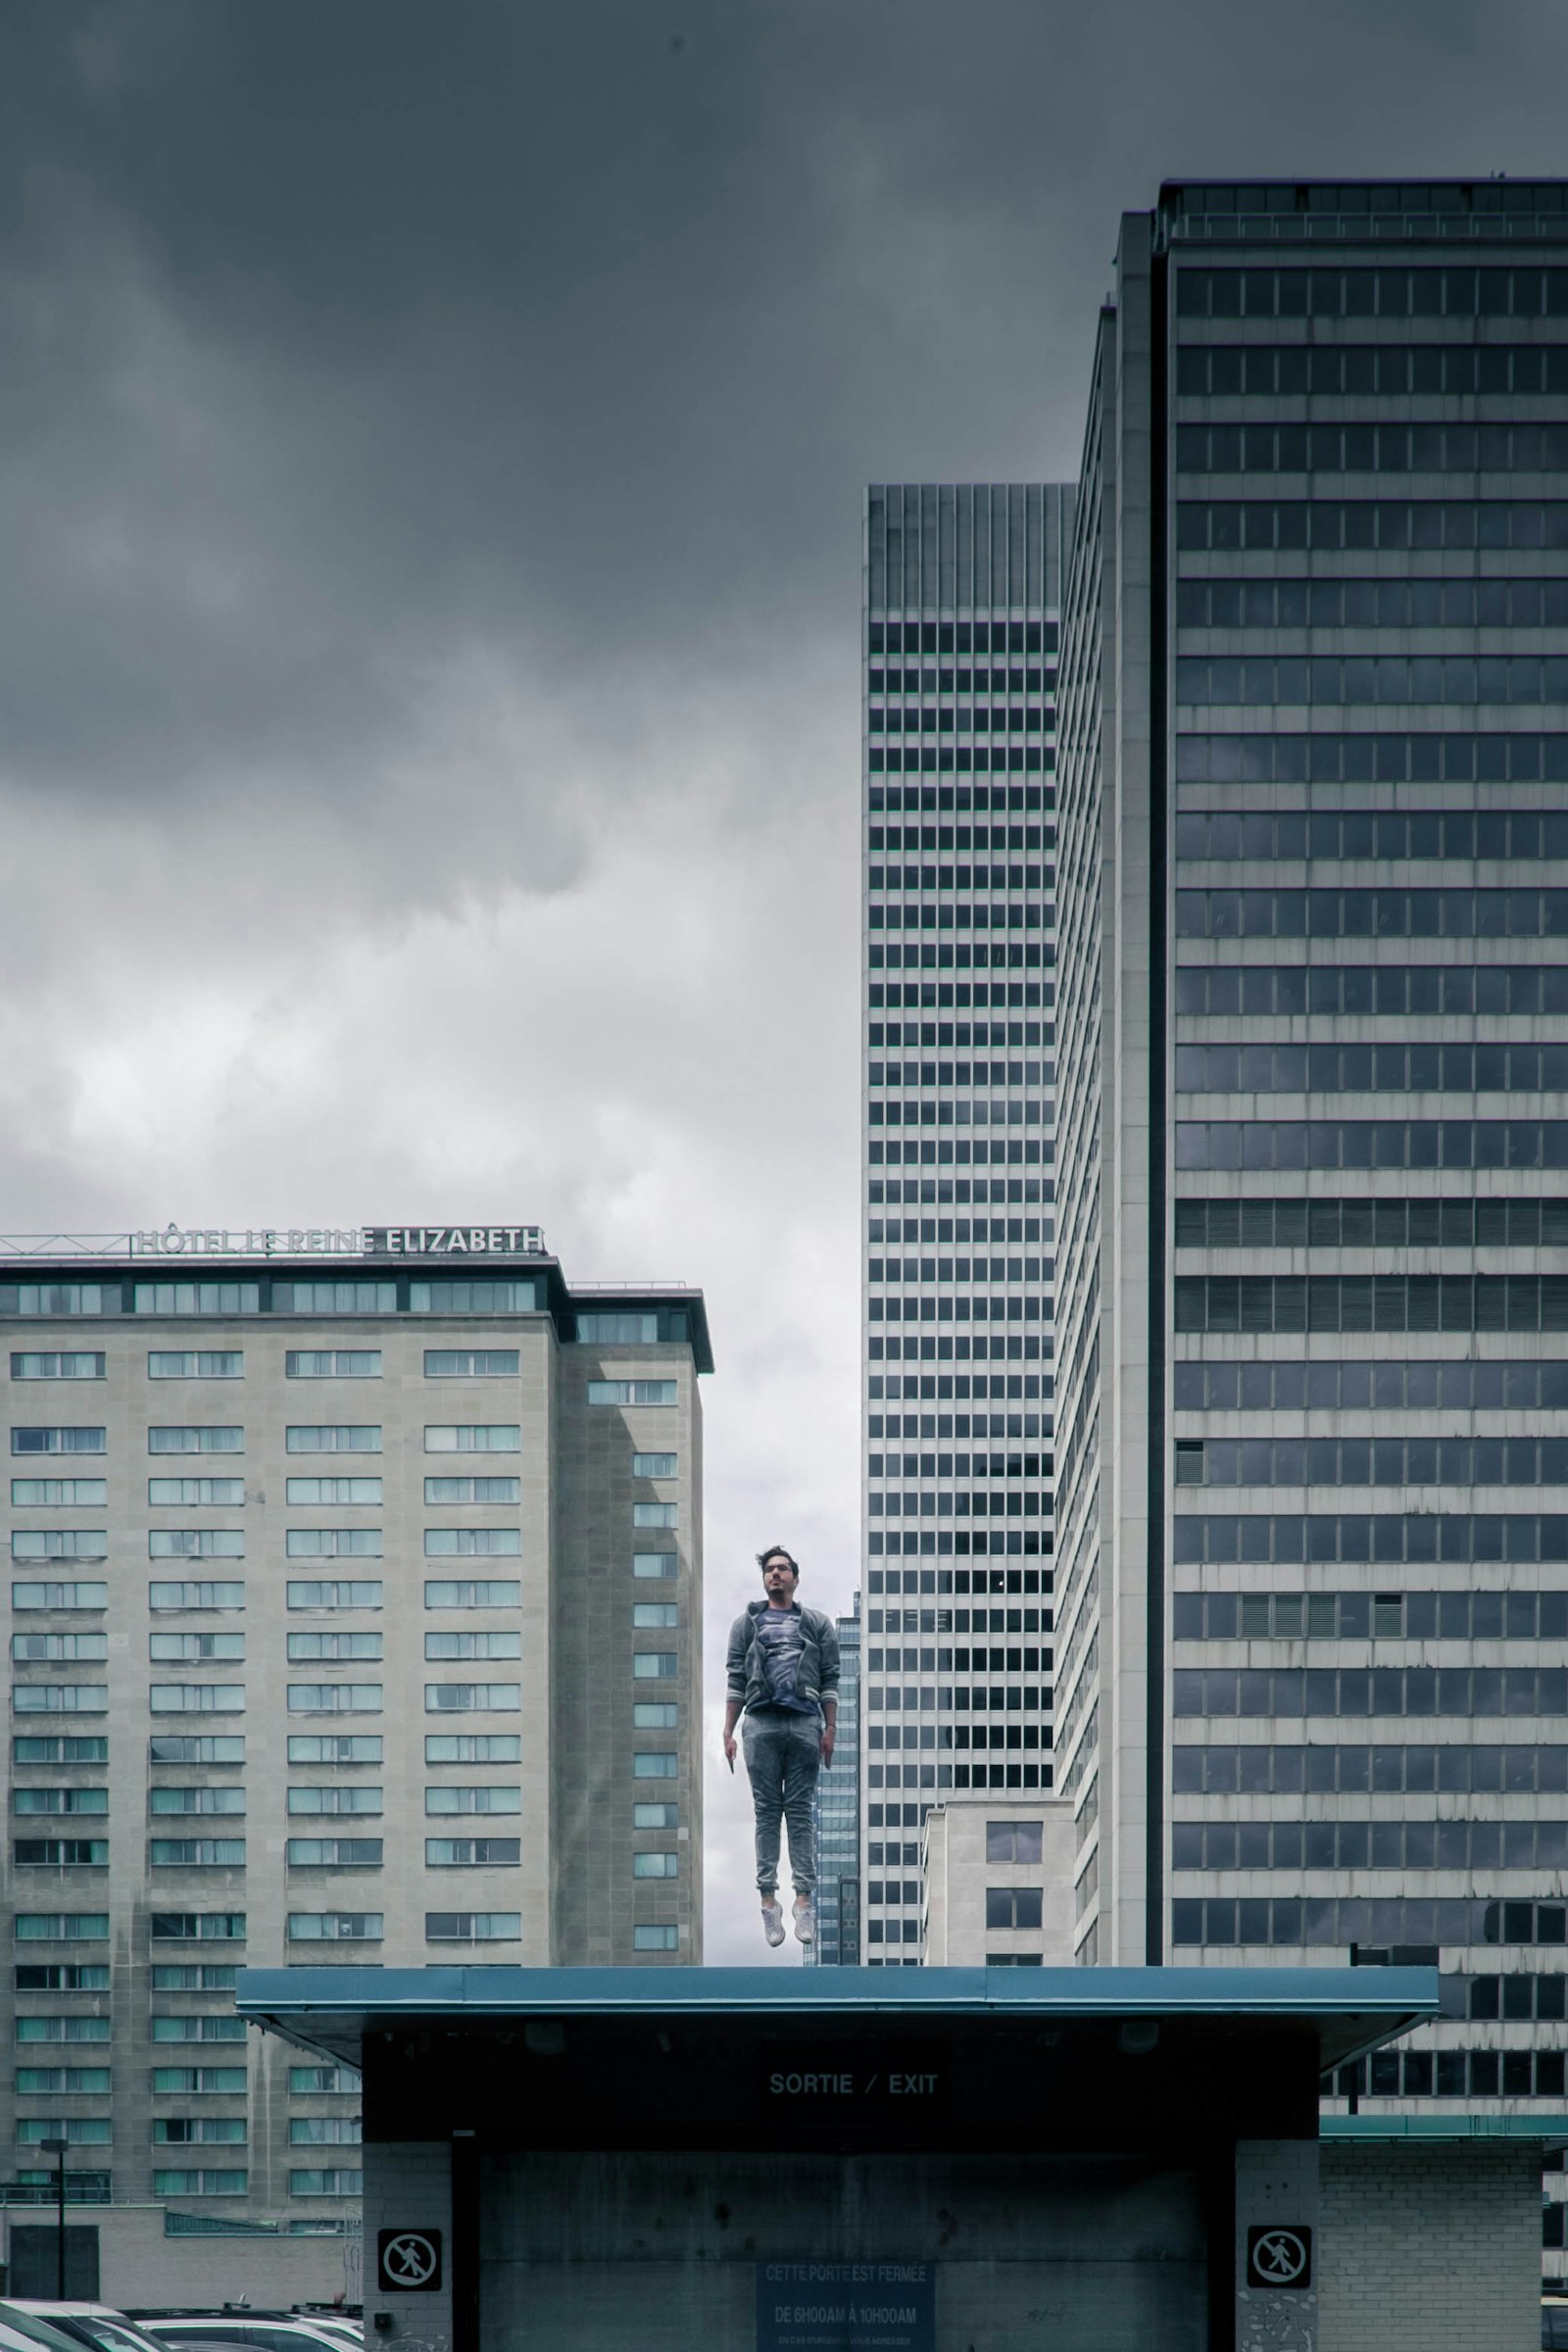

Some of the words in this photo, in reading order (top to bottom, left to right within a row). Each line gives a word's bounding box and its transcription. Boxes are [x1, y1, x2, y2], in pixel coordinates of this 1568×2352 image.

[136, 1222, 235, 1253] HÔTEL
[246, 1230, 276, 1252] LE
[288, 1229, 374, 1252] REINE
[386, 1228, 544, 1252] ELIZABETH
[769, 2073, 854, 2094] SORTIE
[864, 2073, 878, 2094] /
[889, 2074, 939, 2094] EXIT
[765, 2264, 807, 2282] CETTE
[808, 2264, 851, 2282] PORTE
[852, 2265, 875, 2282] EST
[878, 2262, 926, 2281] FERMÉE
[775, 2306, 792, 2324] DE
[794, 2306, 846, 2324] 6H00AM
[860, 2307, 917, 2324] 10H00AM
